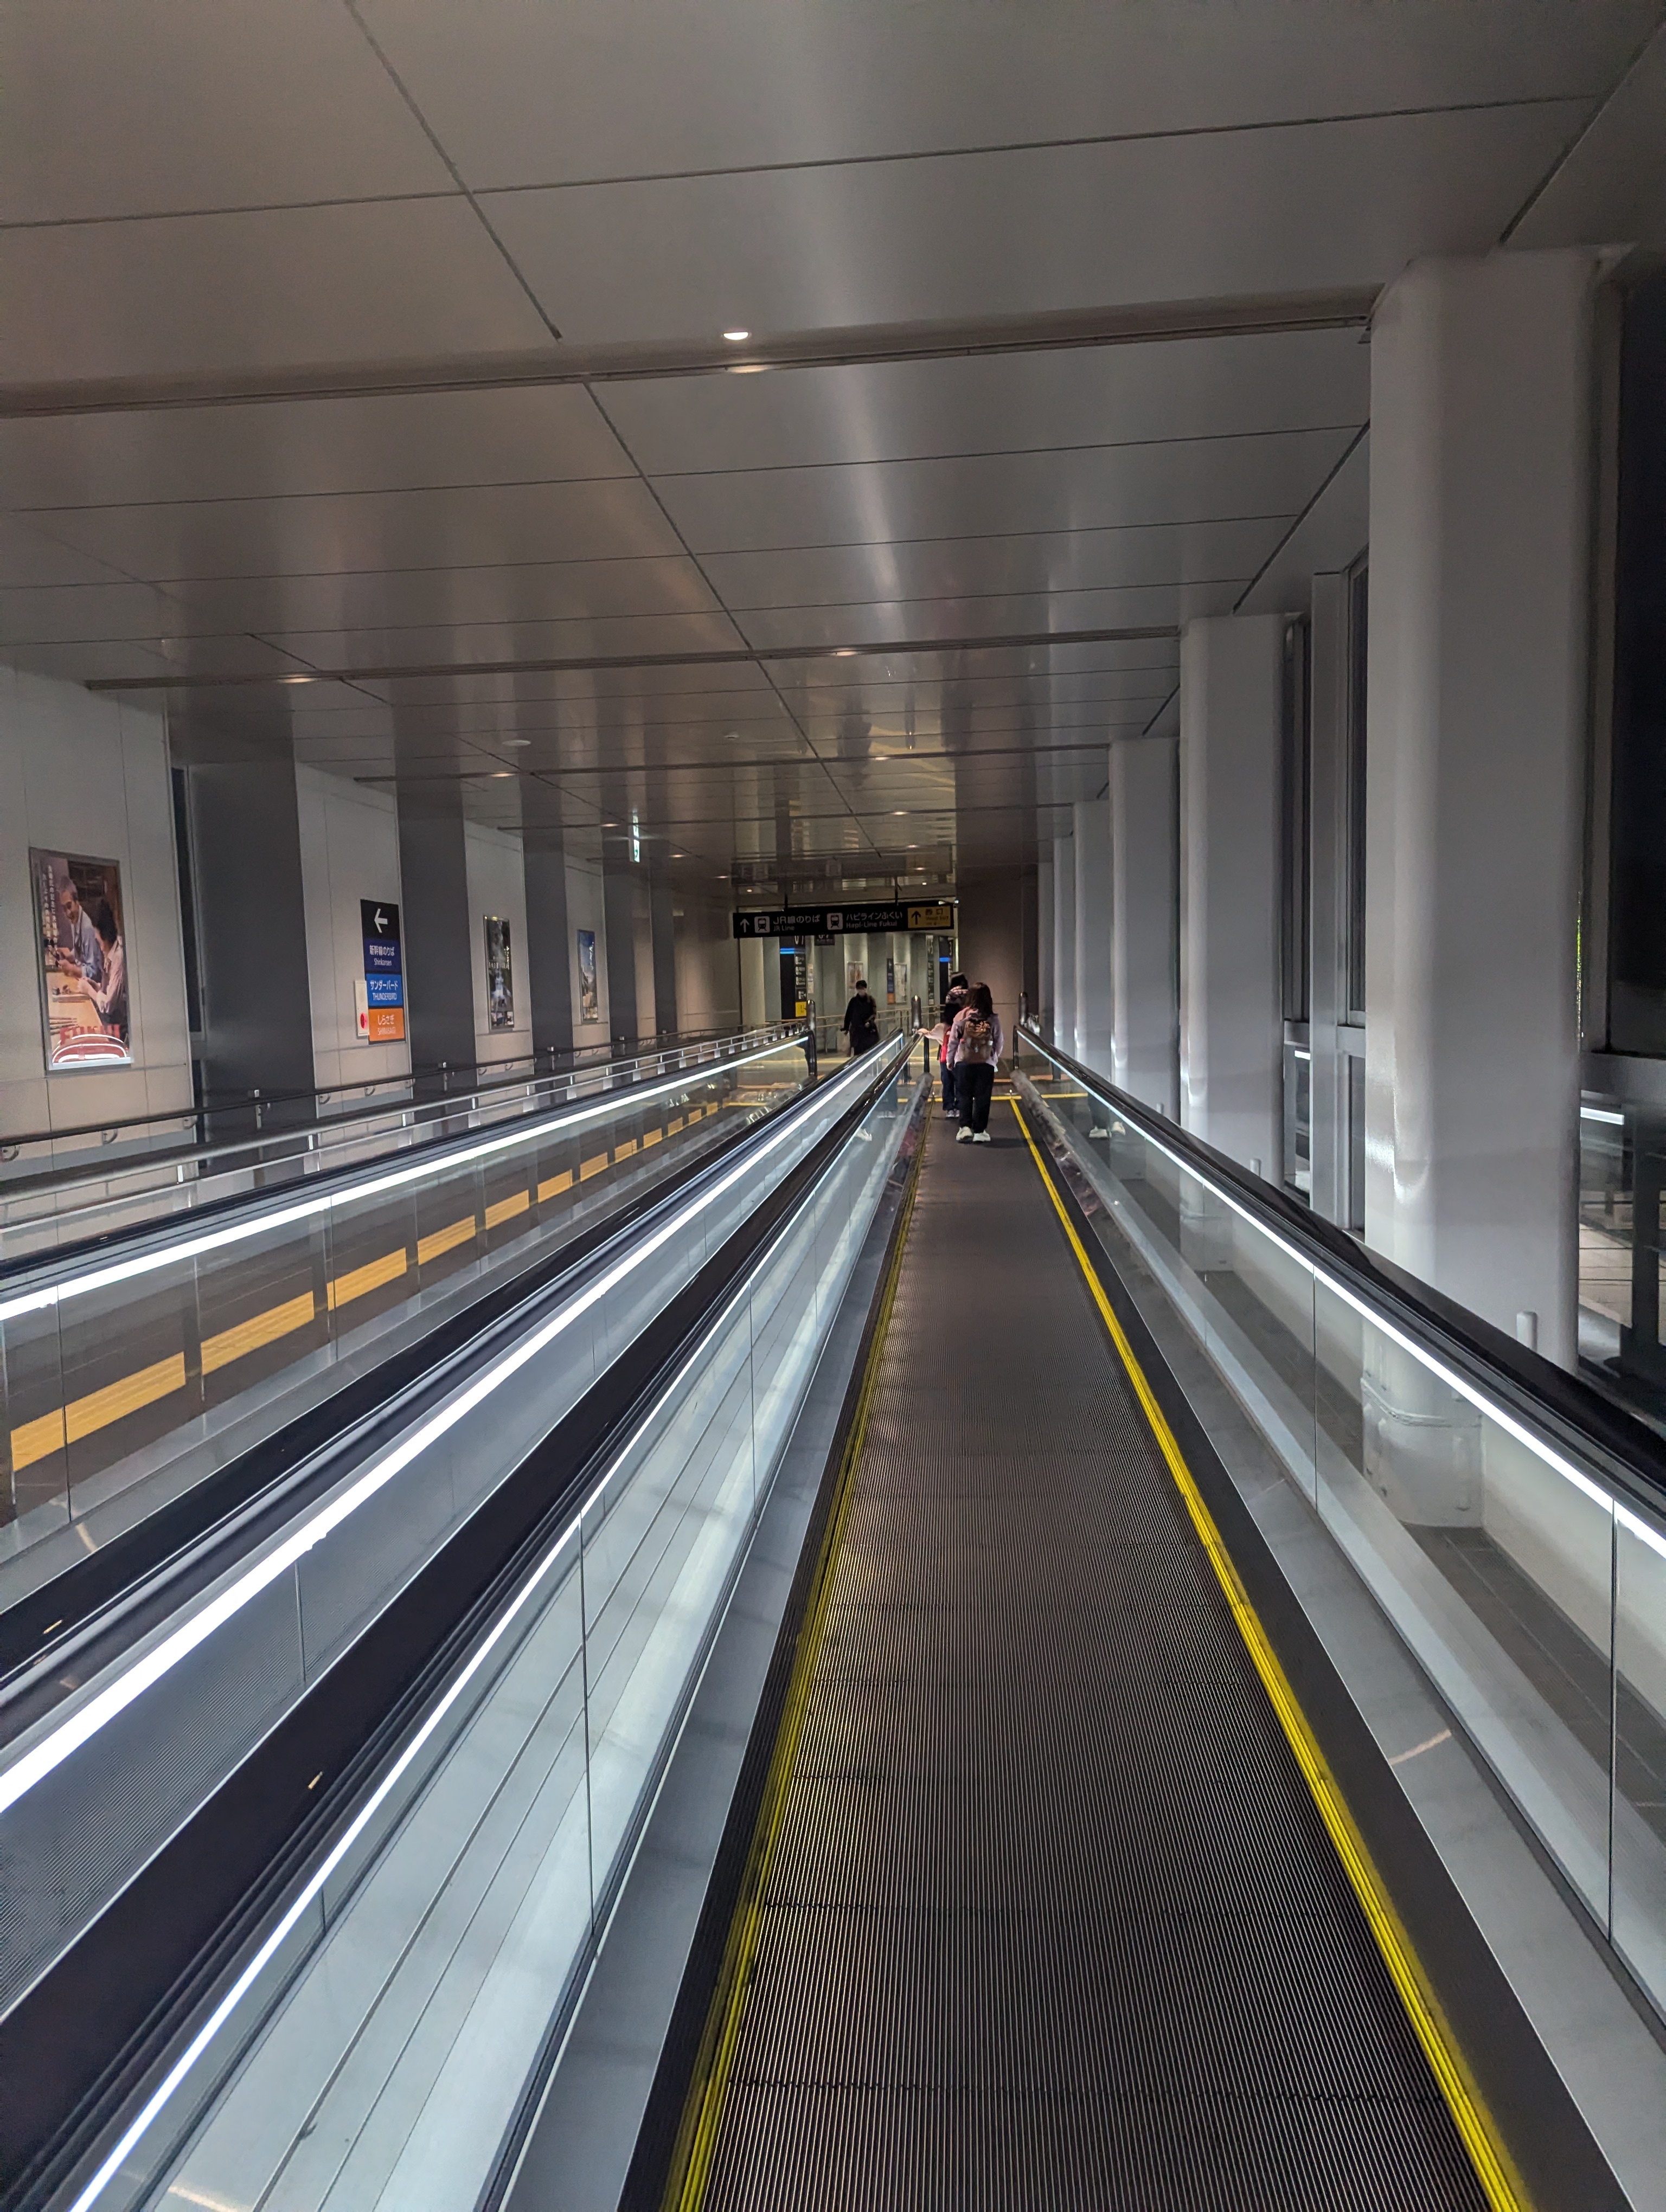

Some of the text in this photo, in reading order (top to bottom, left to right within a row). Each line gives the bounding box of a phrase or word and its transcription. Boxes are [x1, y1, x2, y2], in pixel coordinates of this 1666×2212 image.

[773, 914, 821, 925] JR線のりば
[846, 911, 903, 921] ハピラインふくい
[369, 945, 395, 956] 新幹線のりば
[374, 958, 392, 966] Shinkansen
[370, 980, 398, 991] サンダーバード
[373, 992, 397, 1001] THUNDERBIRD
[377, 1014, 395, 1025] しらさぎ
